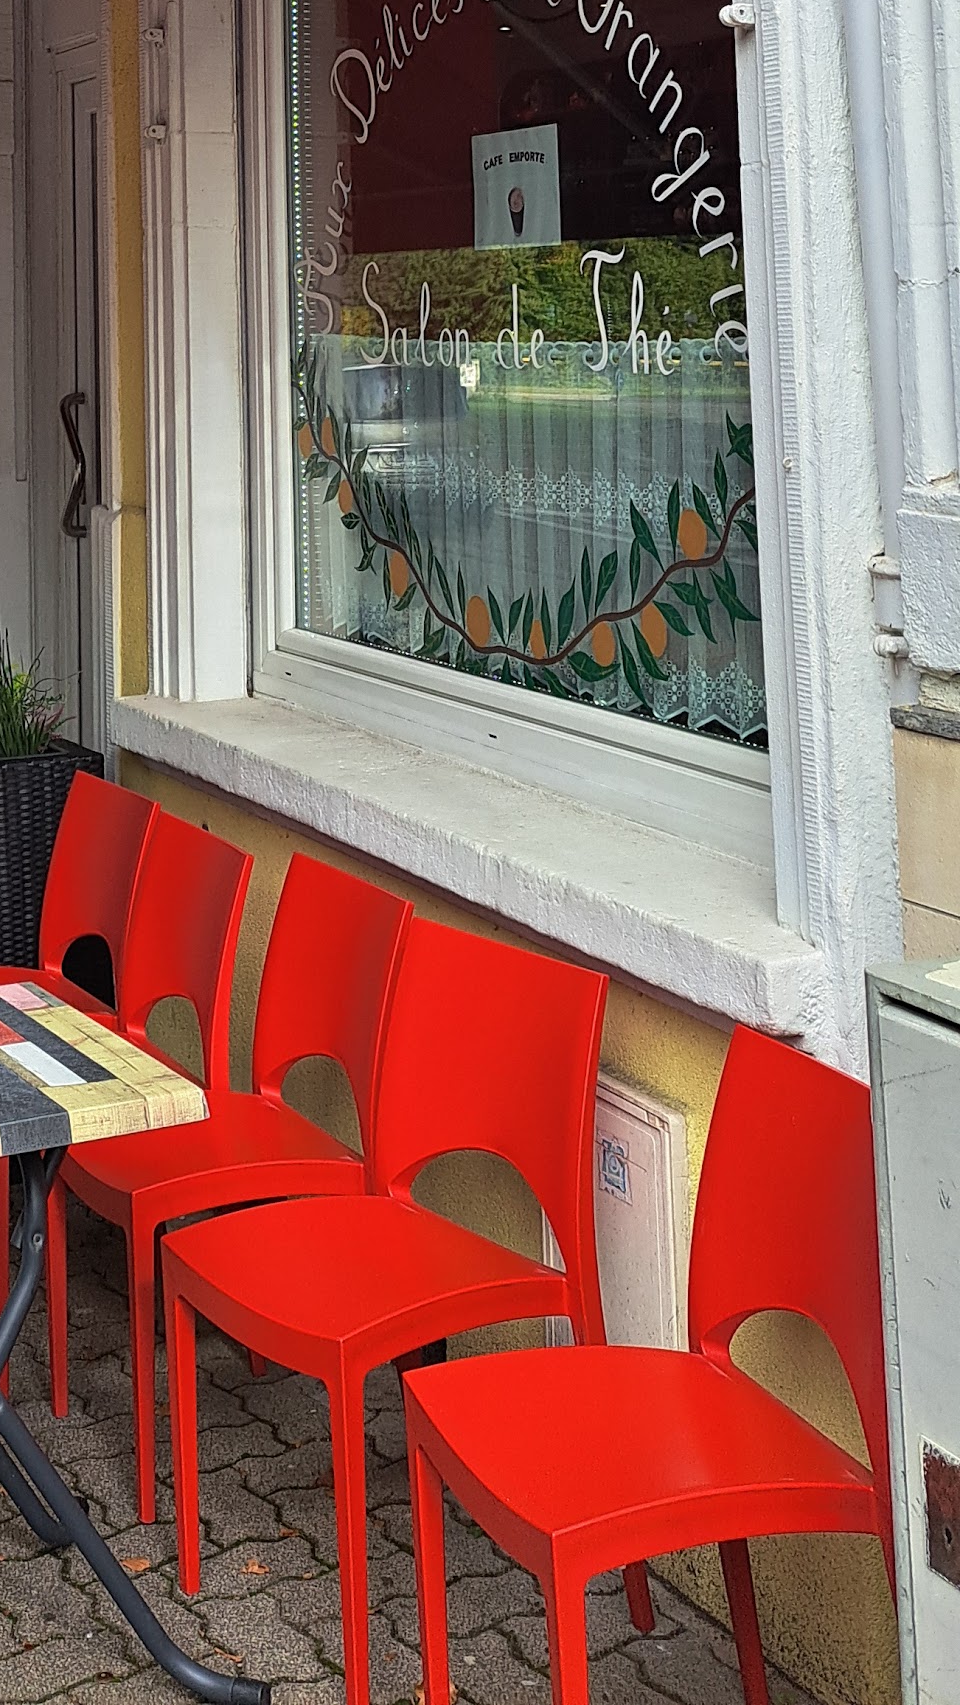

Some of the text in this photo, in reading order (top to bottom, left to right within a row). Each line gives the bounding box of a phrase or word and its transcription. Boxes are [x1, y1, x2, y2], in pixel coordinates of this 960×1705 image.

[483, 151, 545, 171] CAFE EMPORTE
[360, 243, 676, 377] Salon de Thé
